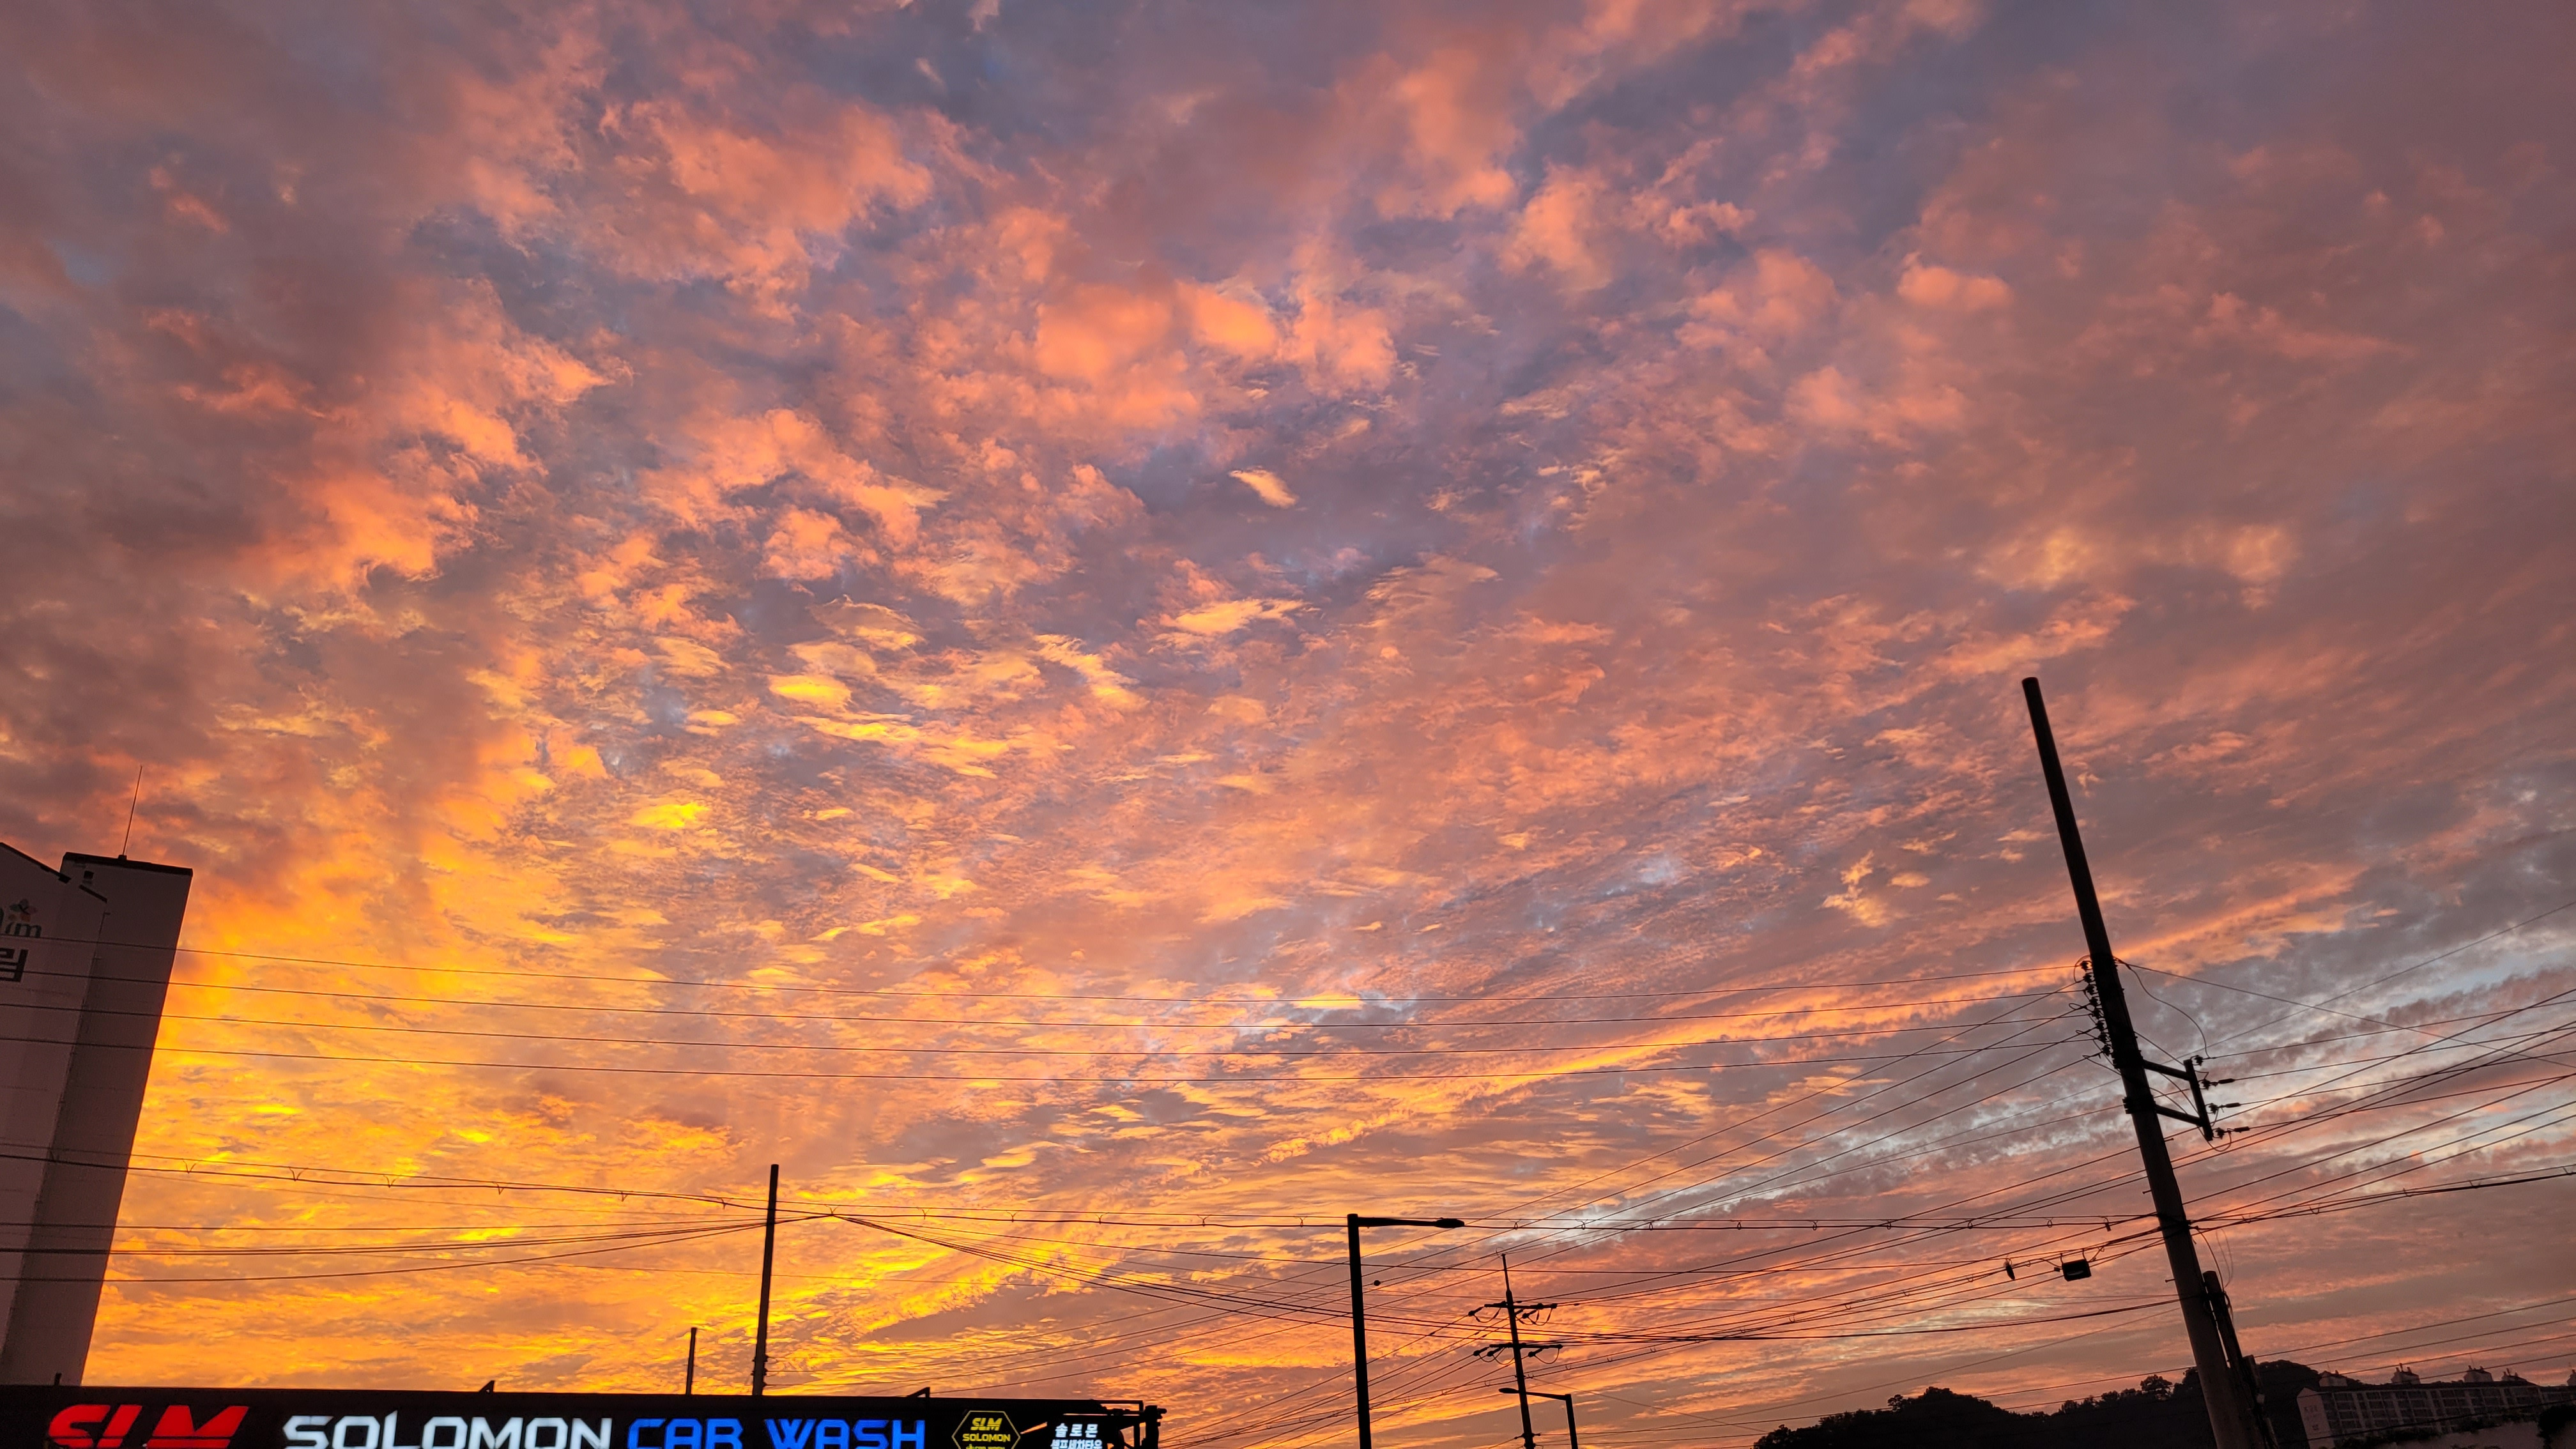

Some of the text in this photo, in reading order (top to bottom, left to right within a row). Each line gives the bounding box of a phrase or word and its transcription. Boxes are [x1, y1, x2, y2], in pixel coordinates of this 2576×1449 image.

[282, 1410, 612, 1449] SOLOMON
[627, 1418, 743, 1449] CAR
[764, 1418, 925, 1449] WASH
[970, 1418, 1002, 1431] SLM
[962, 1433, 1011, 1442] SOLOMON
